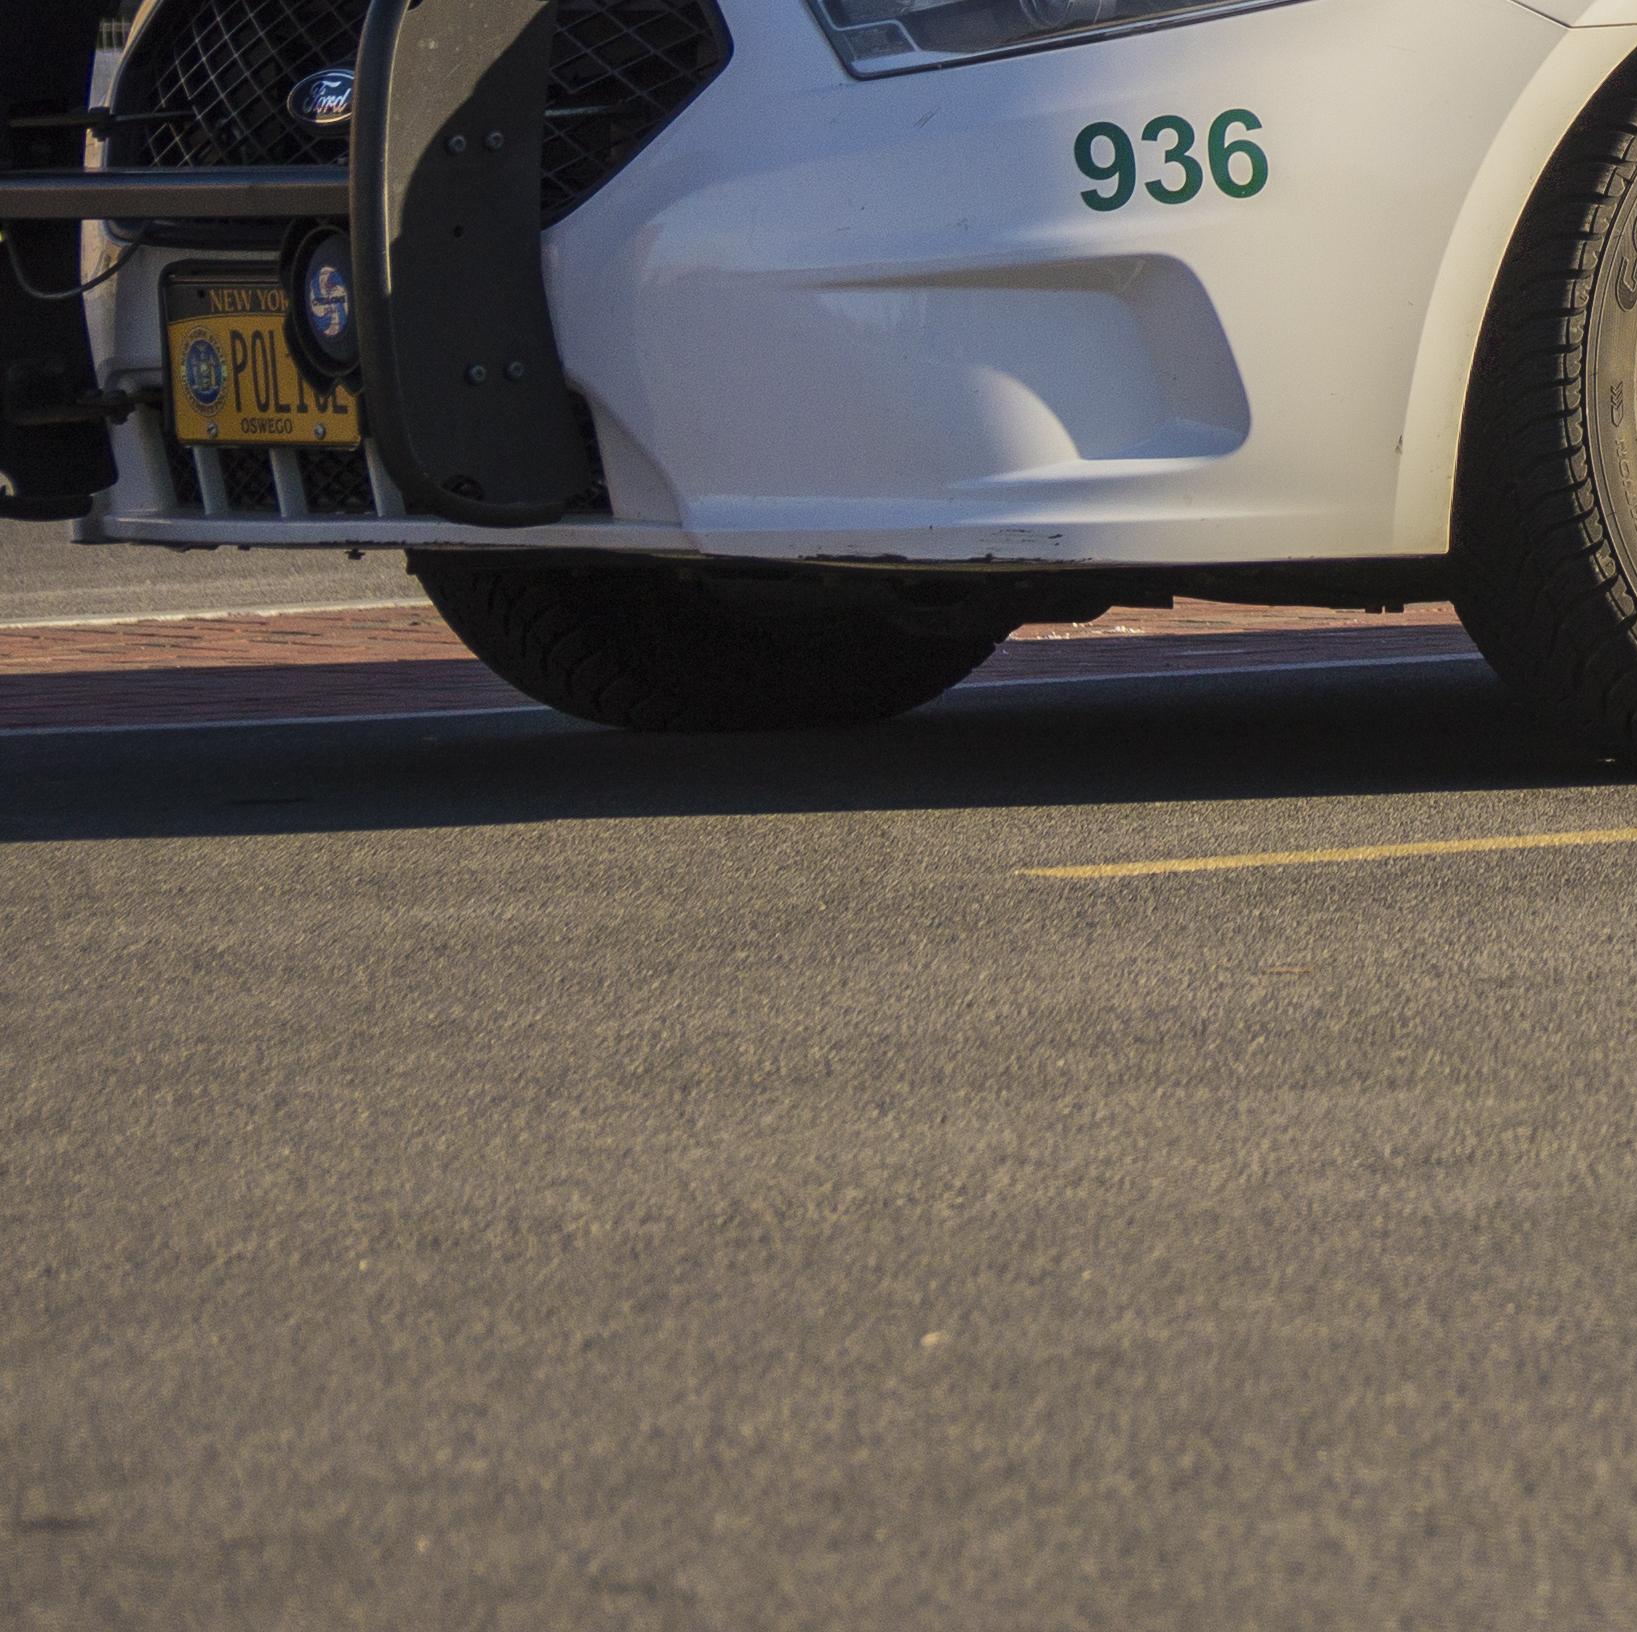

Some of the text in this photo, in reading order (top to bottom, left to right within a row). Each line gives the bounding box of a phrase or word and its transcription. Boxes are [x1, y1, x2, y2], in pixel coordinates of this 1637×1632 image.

[303, 80, 353, 114] Ford
[1073, 108, 1269, 212] 936
[209, 288, 252, 313] NEW
[228, 329, 348, 414] POLI
[240, 417, 293, 435] OSWEGO
